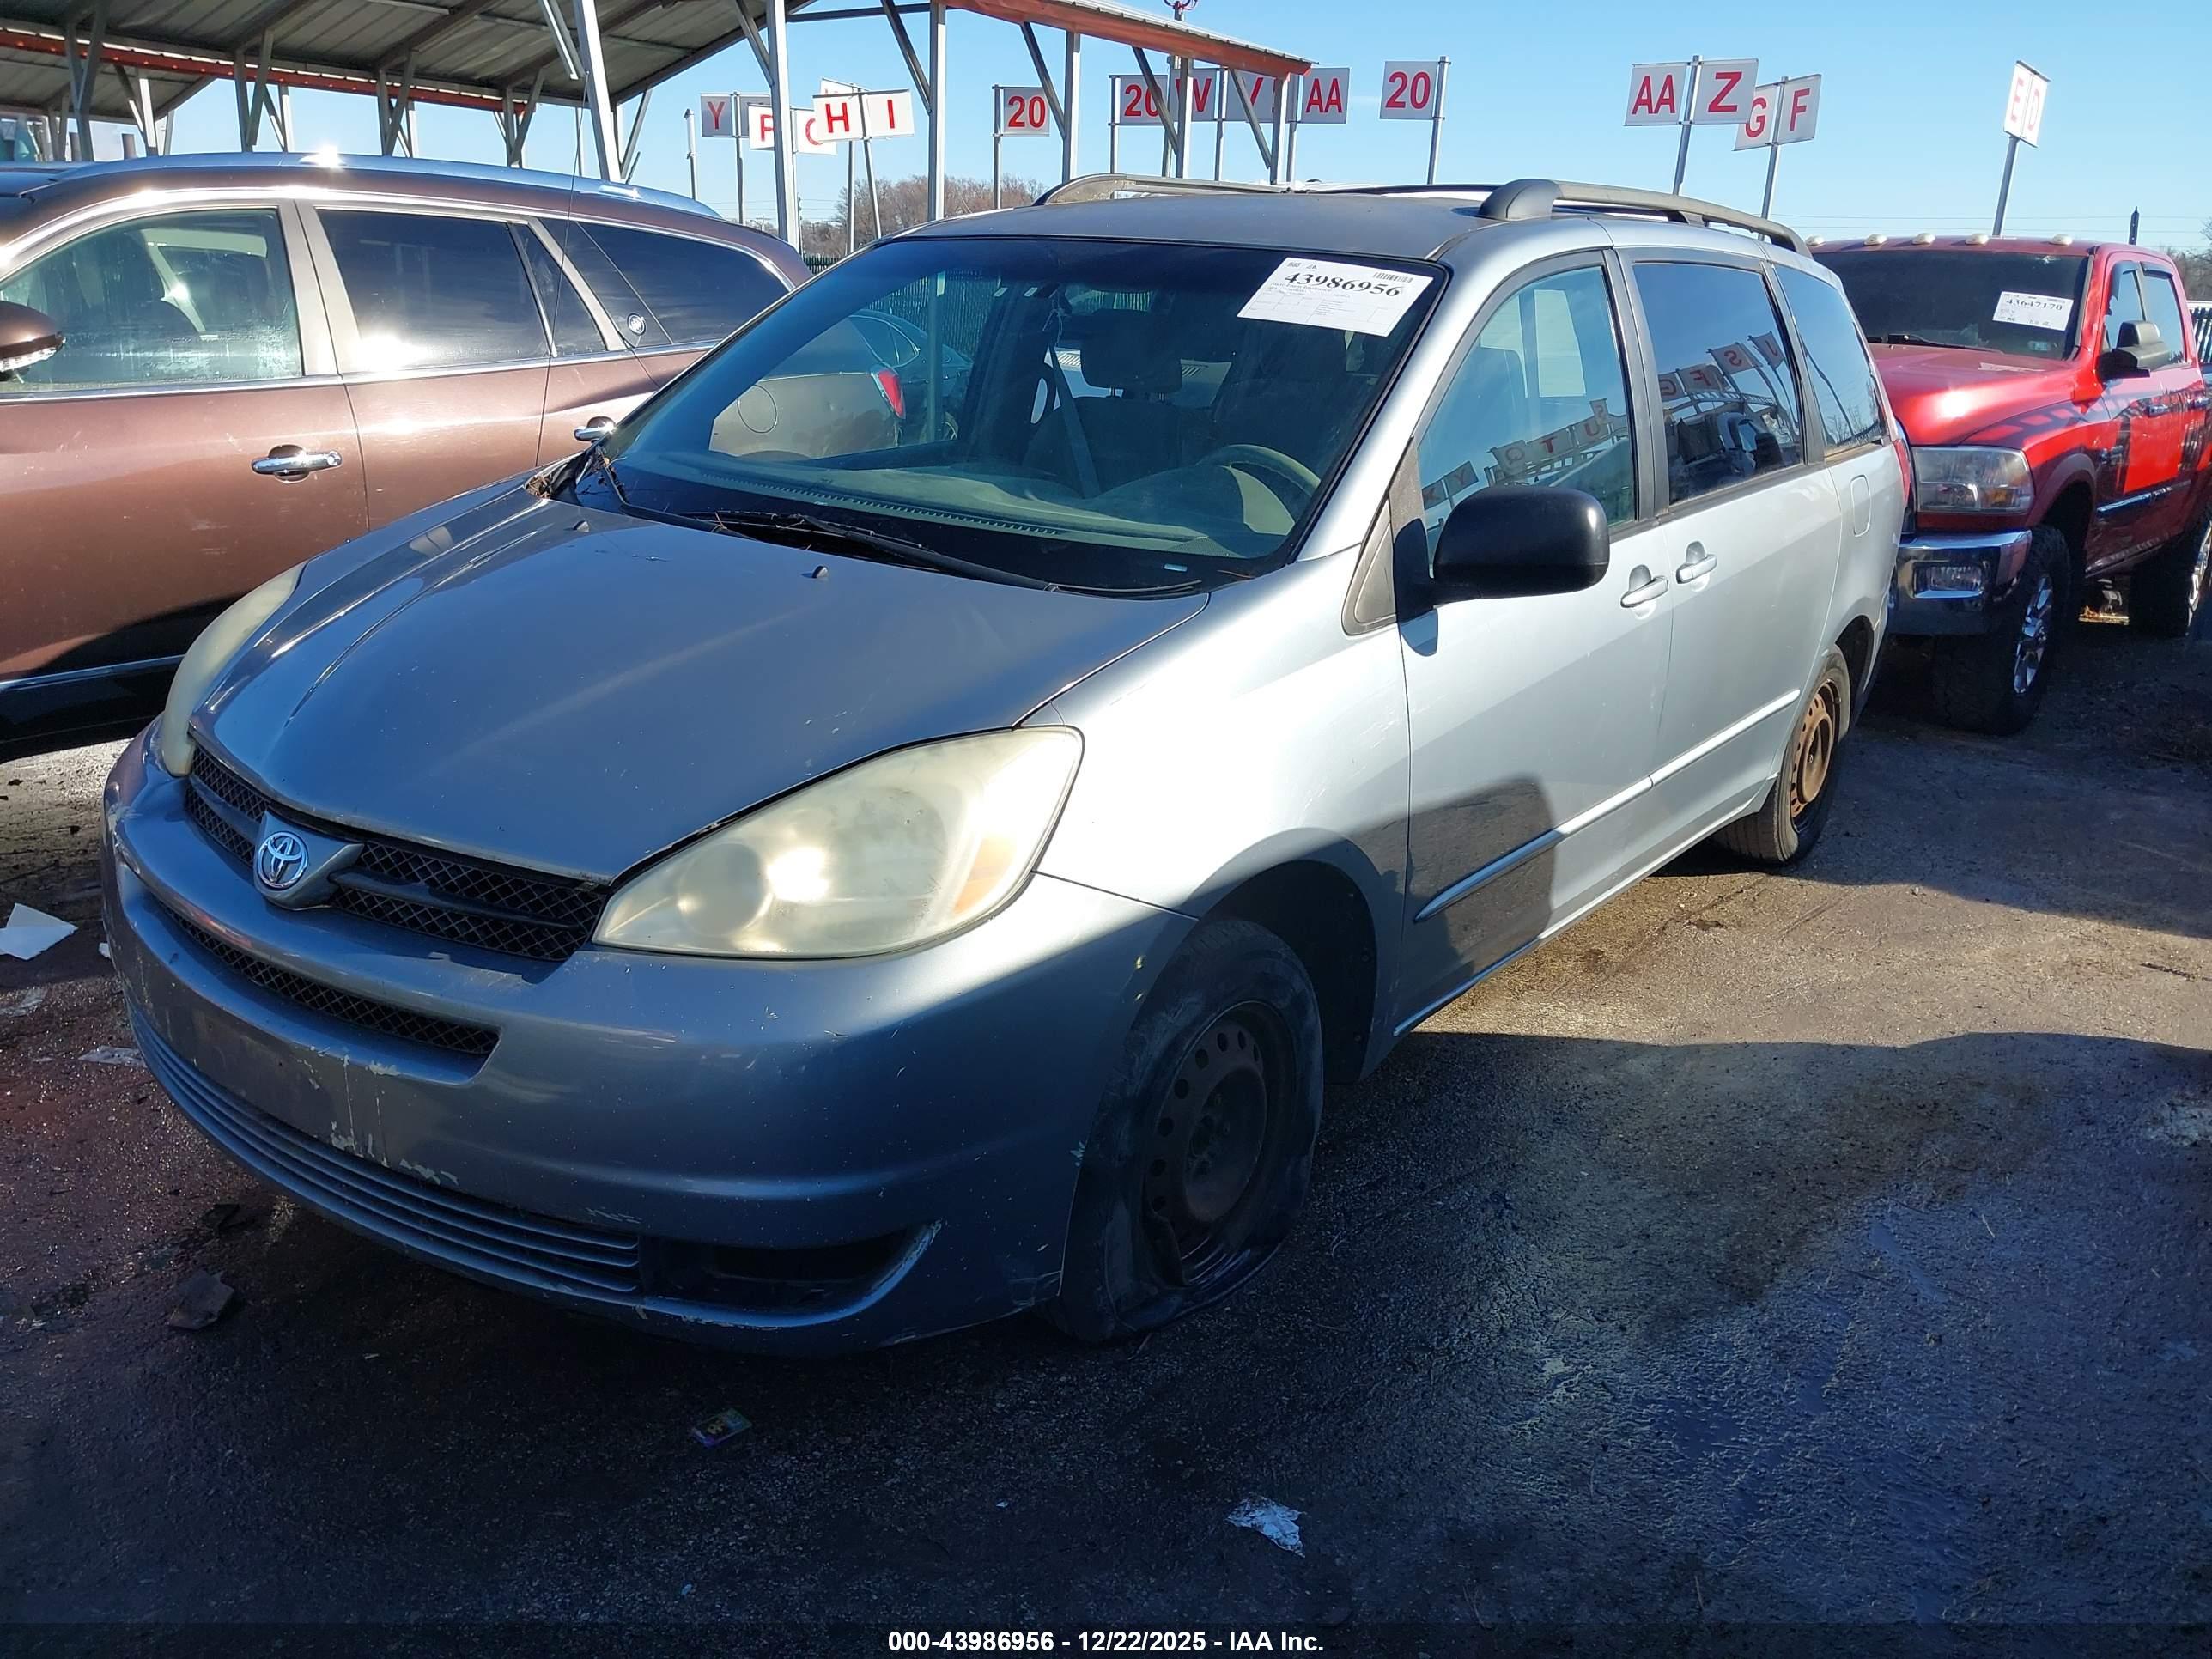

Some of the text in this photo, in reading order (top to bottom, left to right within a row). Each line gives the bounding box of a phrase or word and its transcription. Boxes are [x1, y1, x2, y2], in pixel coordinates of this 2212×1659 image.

[1175, 78, 1212, 112] W
[1305, 77, 1343, 113] AA
[1385, 71, 1432, 110] 20
[1631, 74, 1676, 115] AA
[1707, 71, 1743, 113] Z
[2010, 76, 2024, 123] E
[707, 101, 726, 130] Y
[825, 102, 849, 133] H
[886, 99, 896, 129] I
[1008, 95, 1046, 128] 20
[1745, 97, 1767, 138] G
[1789, 88, 1810, 131] F
[1284, 272, 1404, 297] 43986956
